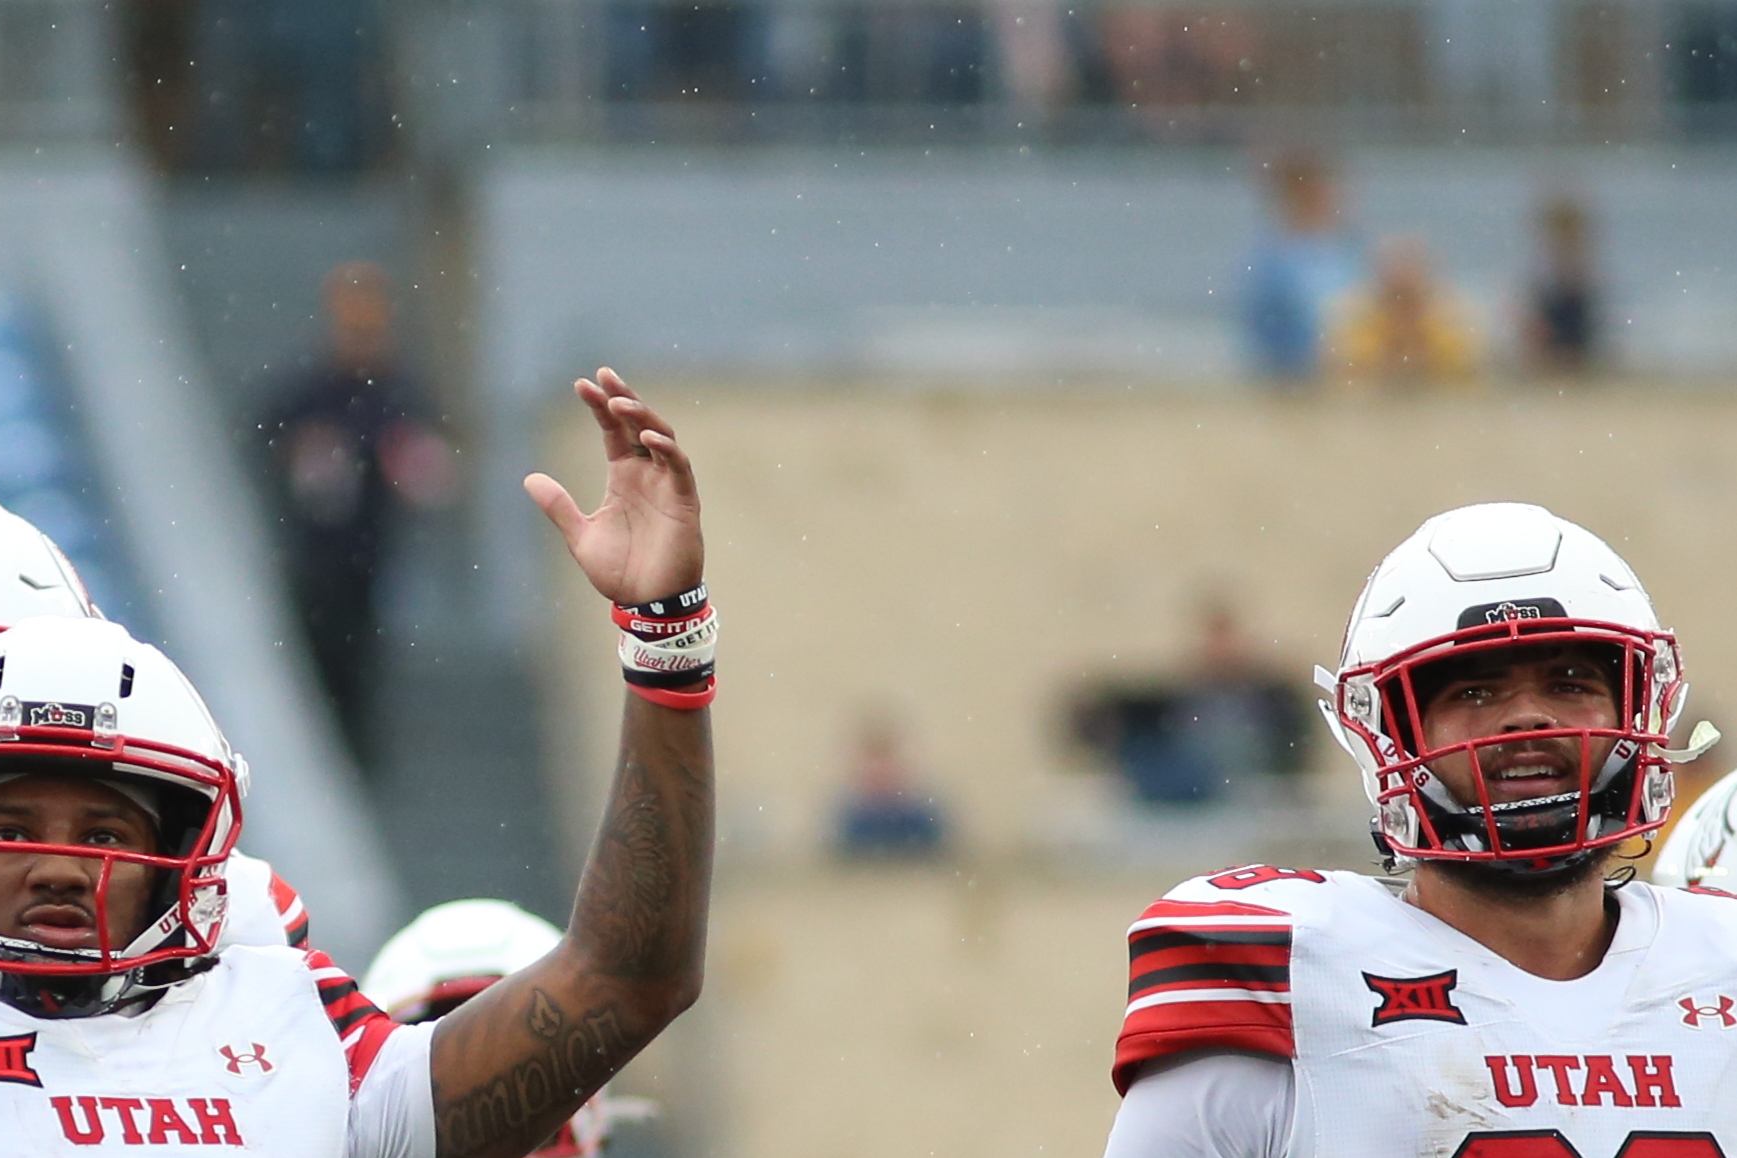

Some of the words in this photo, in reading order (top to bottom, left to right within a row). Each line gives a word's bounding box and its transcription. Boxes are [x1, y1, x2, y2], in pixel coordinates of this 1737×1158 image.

[630, 619, 665, 633] GET
[667, 622, 684, 634] IT
[675, 630, 704, 648] GET
[634, 645, 666, 670] Utah
[1484, 1055, 1682, 1108] UTAH
[49, 1096, 244, 1146] UTAH
